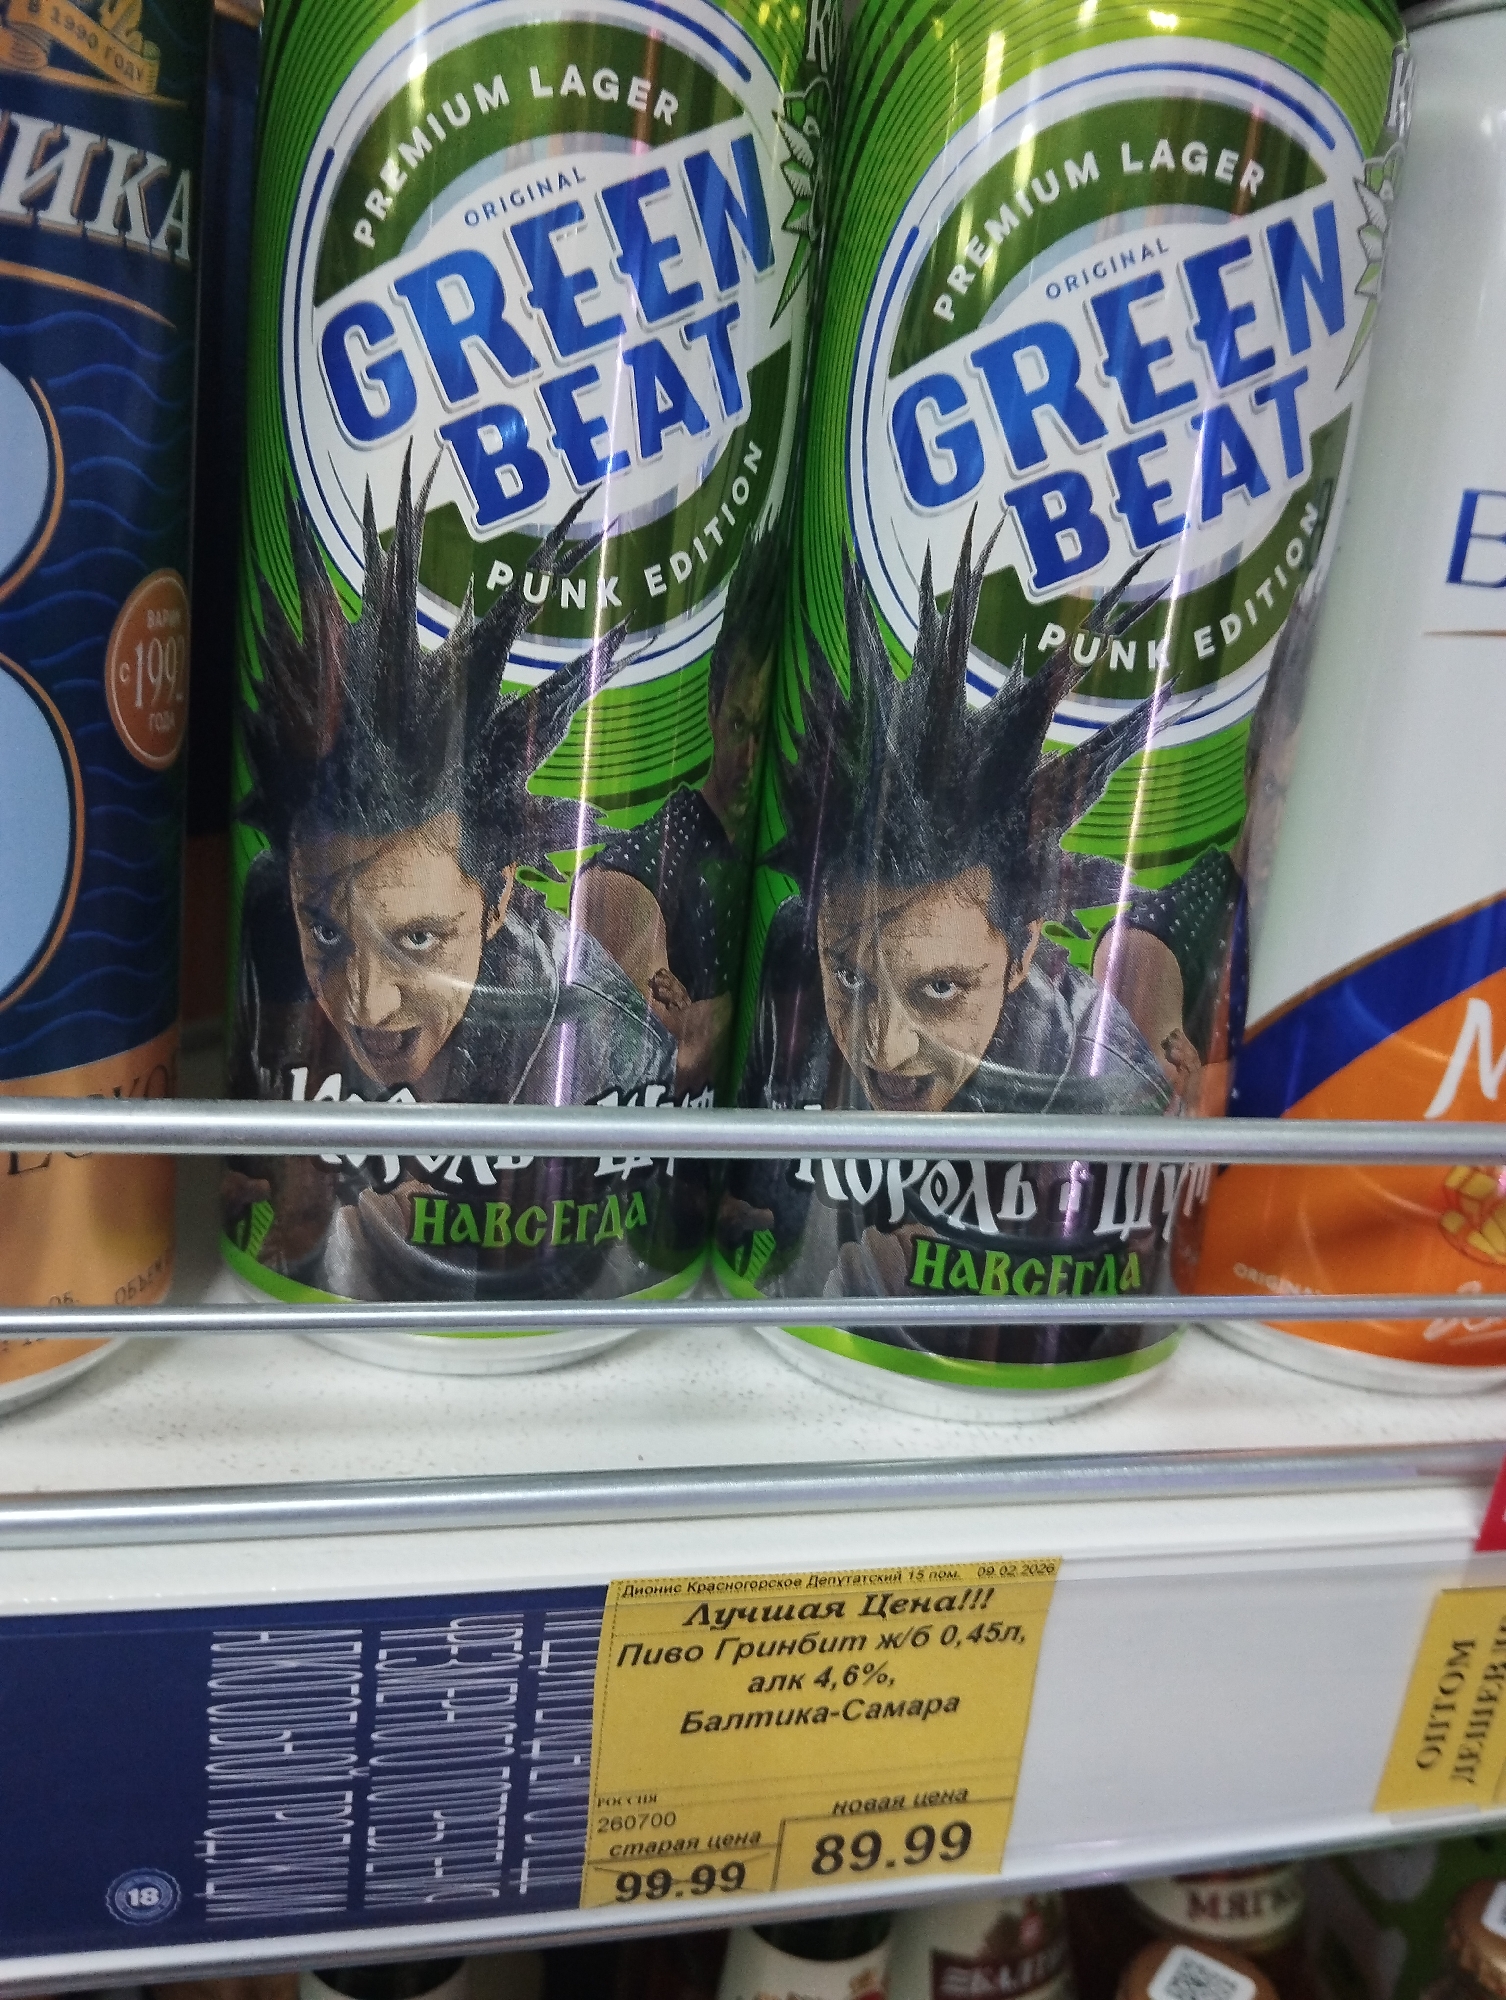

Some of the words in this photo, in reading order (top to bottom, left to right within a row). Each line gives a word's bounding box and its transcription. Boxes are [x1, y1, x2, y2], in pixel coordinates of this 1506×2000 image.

[0, 110, 190, 262] ИКА
[354, 75, 510, 250] PREMIUM
[530, 63, 680, 126] LAGER
[463, 167, 587, 228] ORIGINAL
[933, 150, 1101, 322] PREMIUM
[1121, 138, 1266, 196] LAGER
[318, 133, 775, 446] GREEN
[1046, 237, 1170, 299] ORIGINAL
[889, 201, 1347, 511] GREEN
[436, 303, 746, 531] BEAT
[1003, 367, 1310, 593] BEAT
[487, 559, 621, 610] PUNK
[645, 440, 762, 598] EDITION
[1039, 621, 1170, 671] PUNK
[1195, 502, 1318, 659] EDITION
[621, 1583, 682, 1598] Дионис
[687, 1577, 802, 1595] Красногорское
[806, 1570, 902, 1590] Депутатский
[908, 1569, 924, 1581] 15
[928, 1569, 961, 1581] пом.
[682, 1600, 846, 1631] Лучшая
[858, 1587, 995, 1620] Цена!!!
[616, 1641, 704, 1668] Пиво
[714, 1630, 868, 1666] Гринбит
[875, 1623, 934, 1650] ж/б
[939, 1620, 1026, 1649] 0,45л,
[747, 1671, 804, 1695] алк
[813, 1660, 896, 1692] 4,6%,
[679, 1693, 962, 1736] Балтика-Самара
[597, 1811, 677, 1834] 260700
[831, 1794, 906, 1817] новая
[912, 1786, 970, 1808] цена
[609, 1836, 700, 1858] старая
[707, 1829, 762, 1851] цена
[811, 1819, 974, 1877] 89.99
[128, 1887, 160, 1907] 18
[615, 1860, 747, 1903] 99.99
